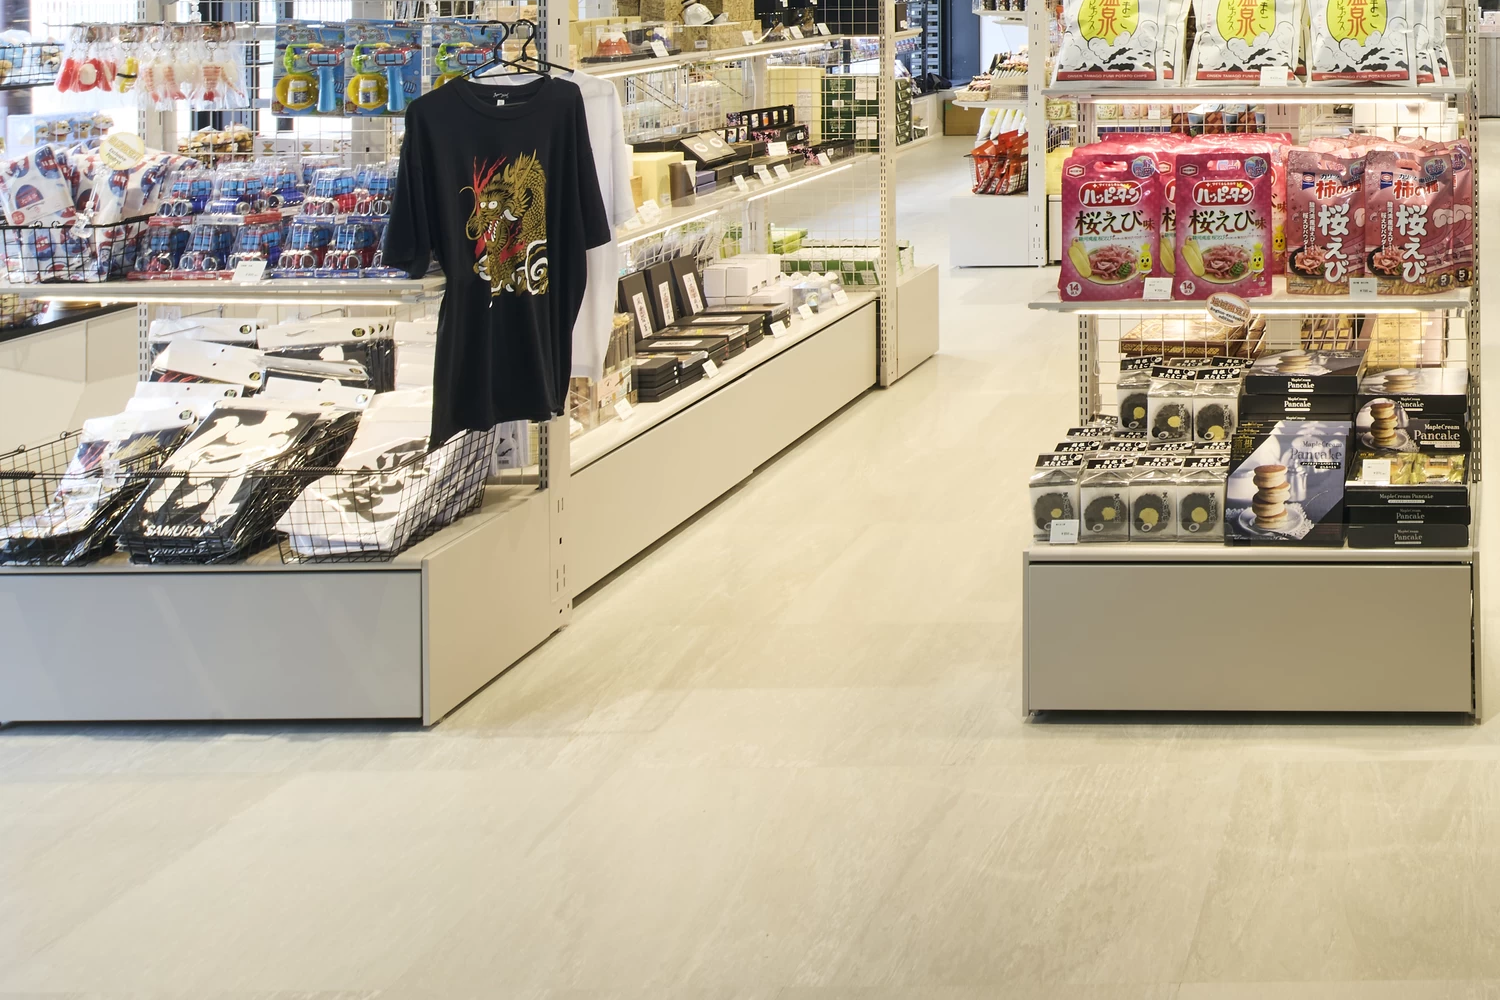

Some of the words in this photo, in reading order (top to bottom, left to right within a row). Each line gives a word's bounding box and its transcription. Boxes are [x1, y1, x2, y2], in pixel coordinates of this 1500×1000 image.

[1082, 186, 1140, 205] ハッピーターン
[1196, 186, 1253, 204] ハッピーターン
[1316, 180, 1362, 200] 柿の種
[1393, 180, 1440, 199] 柿の種
[1074, 210, 1156, 236] 桜えび味
[1188, 209, 1267, 235] 桜えび味
[1440, 274, 1447, 283] 5
[1458, 269, 1466, 278] 5
[1069, 284, 1080, 292] 14
[1182, 282, 1193, 290] 14
[1284, 400, 1312, 408] Pancake
[1414, 430, 1460, 440] Pancake
[1290, 448, 1342, 460] Pancake
